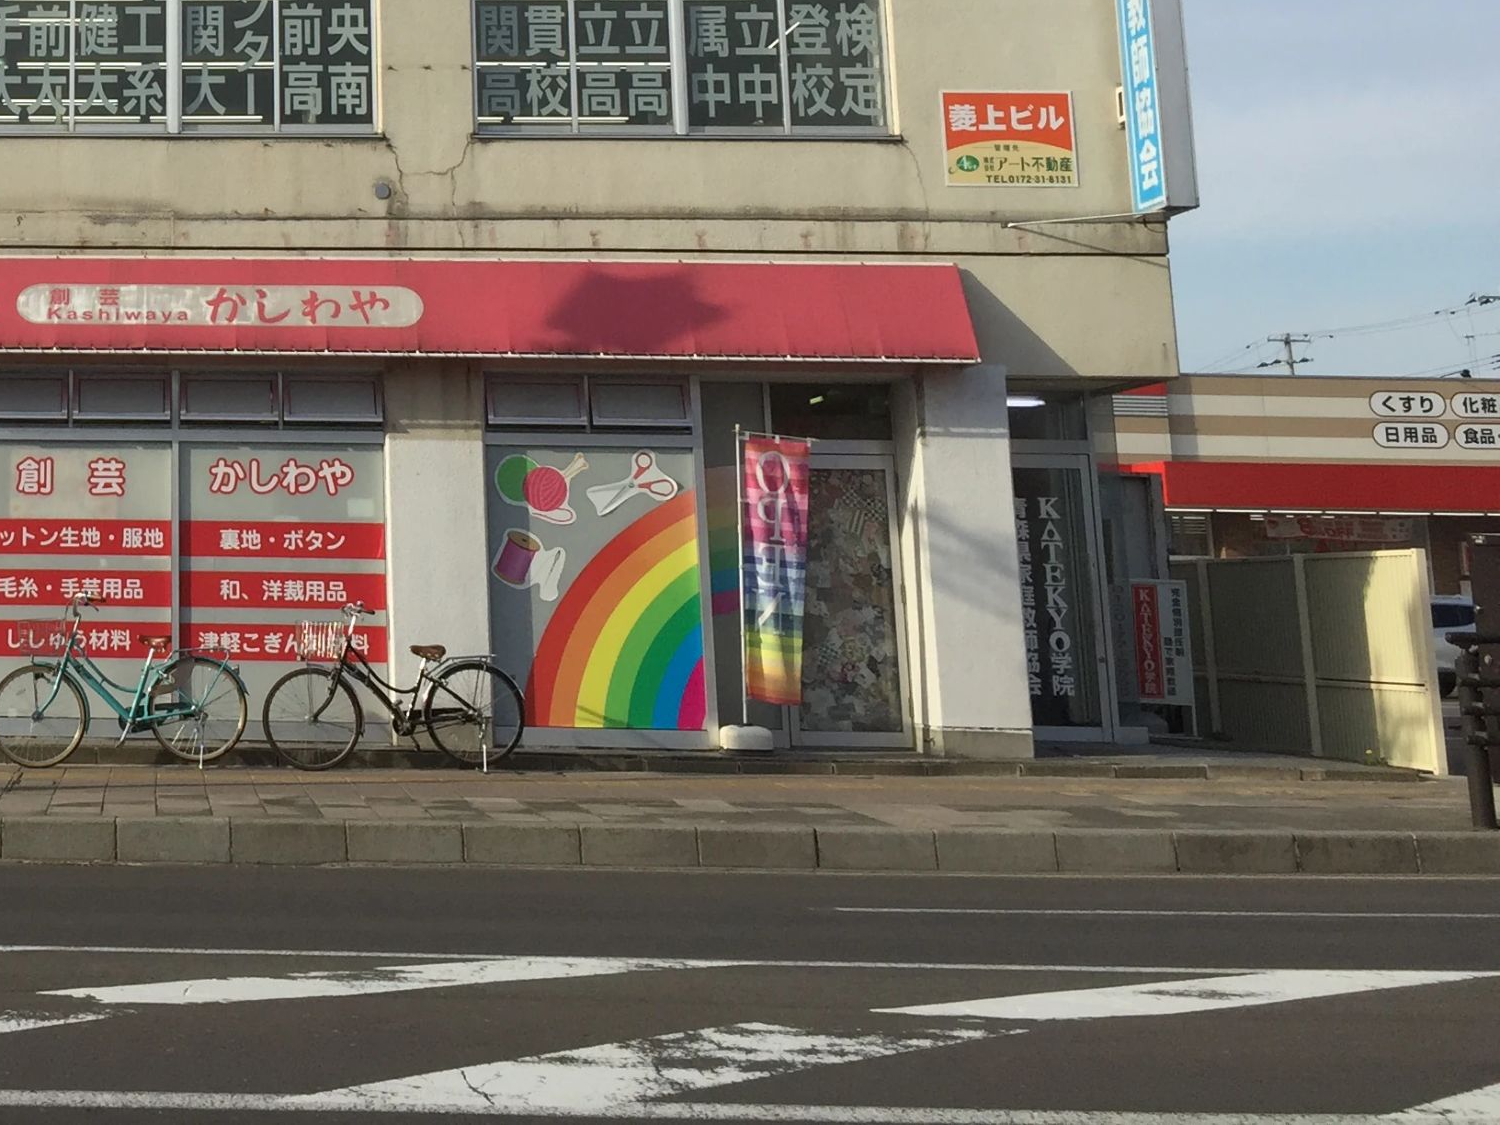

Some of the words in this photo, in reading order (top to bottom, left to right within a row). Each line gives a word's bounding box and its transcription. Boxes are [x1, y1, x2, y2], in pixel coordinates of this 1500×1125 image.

[948, 104, 1065, 132] 菱上ビル
[997, 156, 1073, 172] アート不動産
[46, 307, 189, 322] Kashiwaya
[205, 286, 390, 324] かしわや
[1381, 395, 1435, 414] くすり
[1385, 426, 1438, 444] 日用品
[16, 456, 127, 496] 創芸
[209, 457, 355, 496] かしわや
[218, 528, 347, 551] 裏地・ボタン
[1037, 496, 1076, 697] KATEKYO学院
